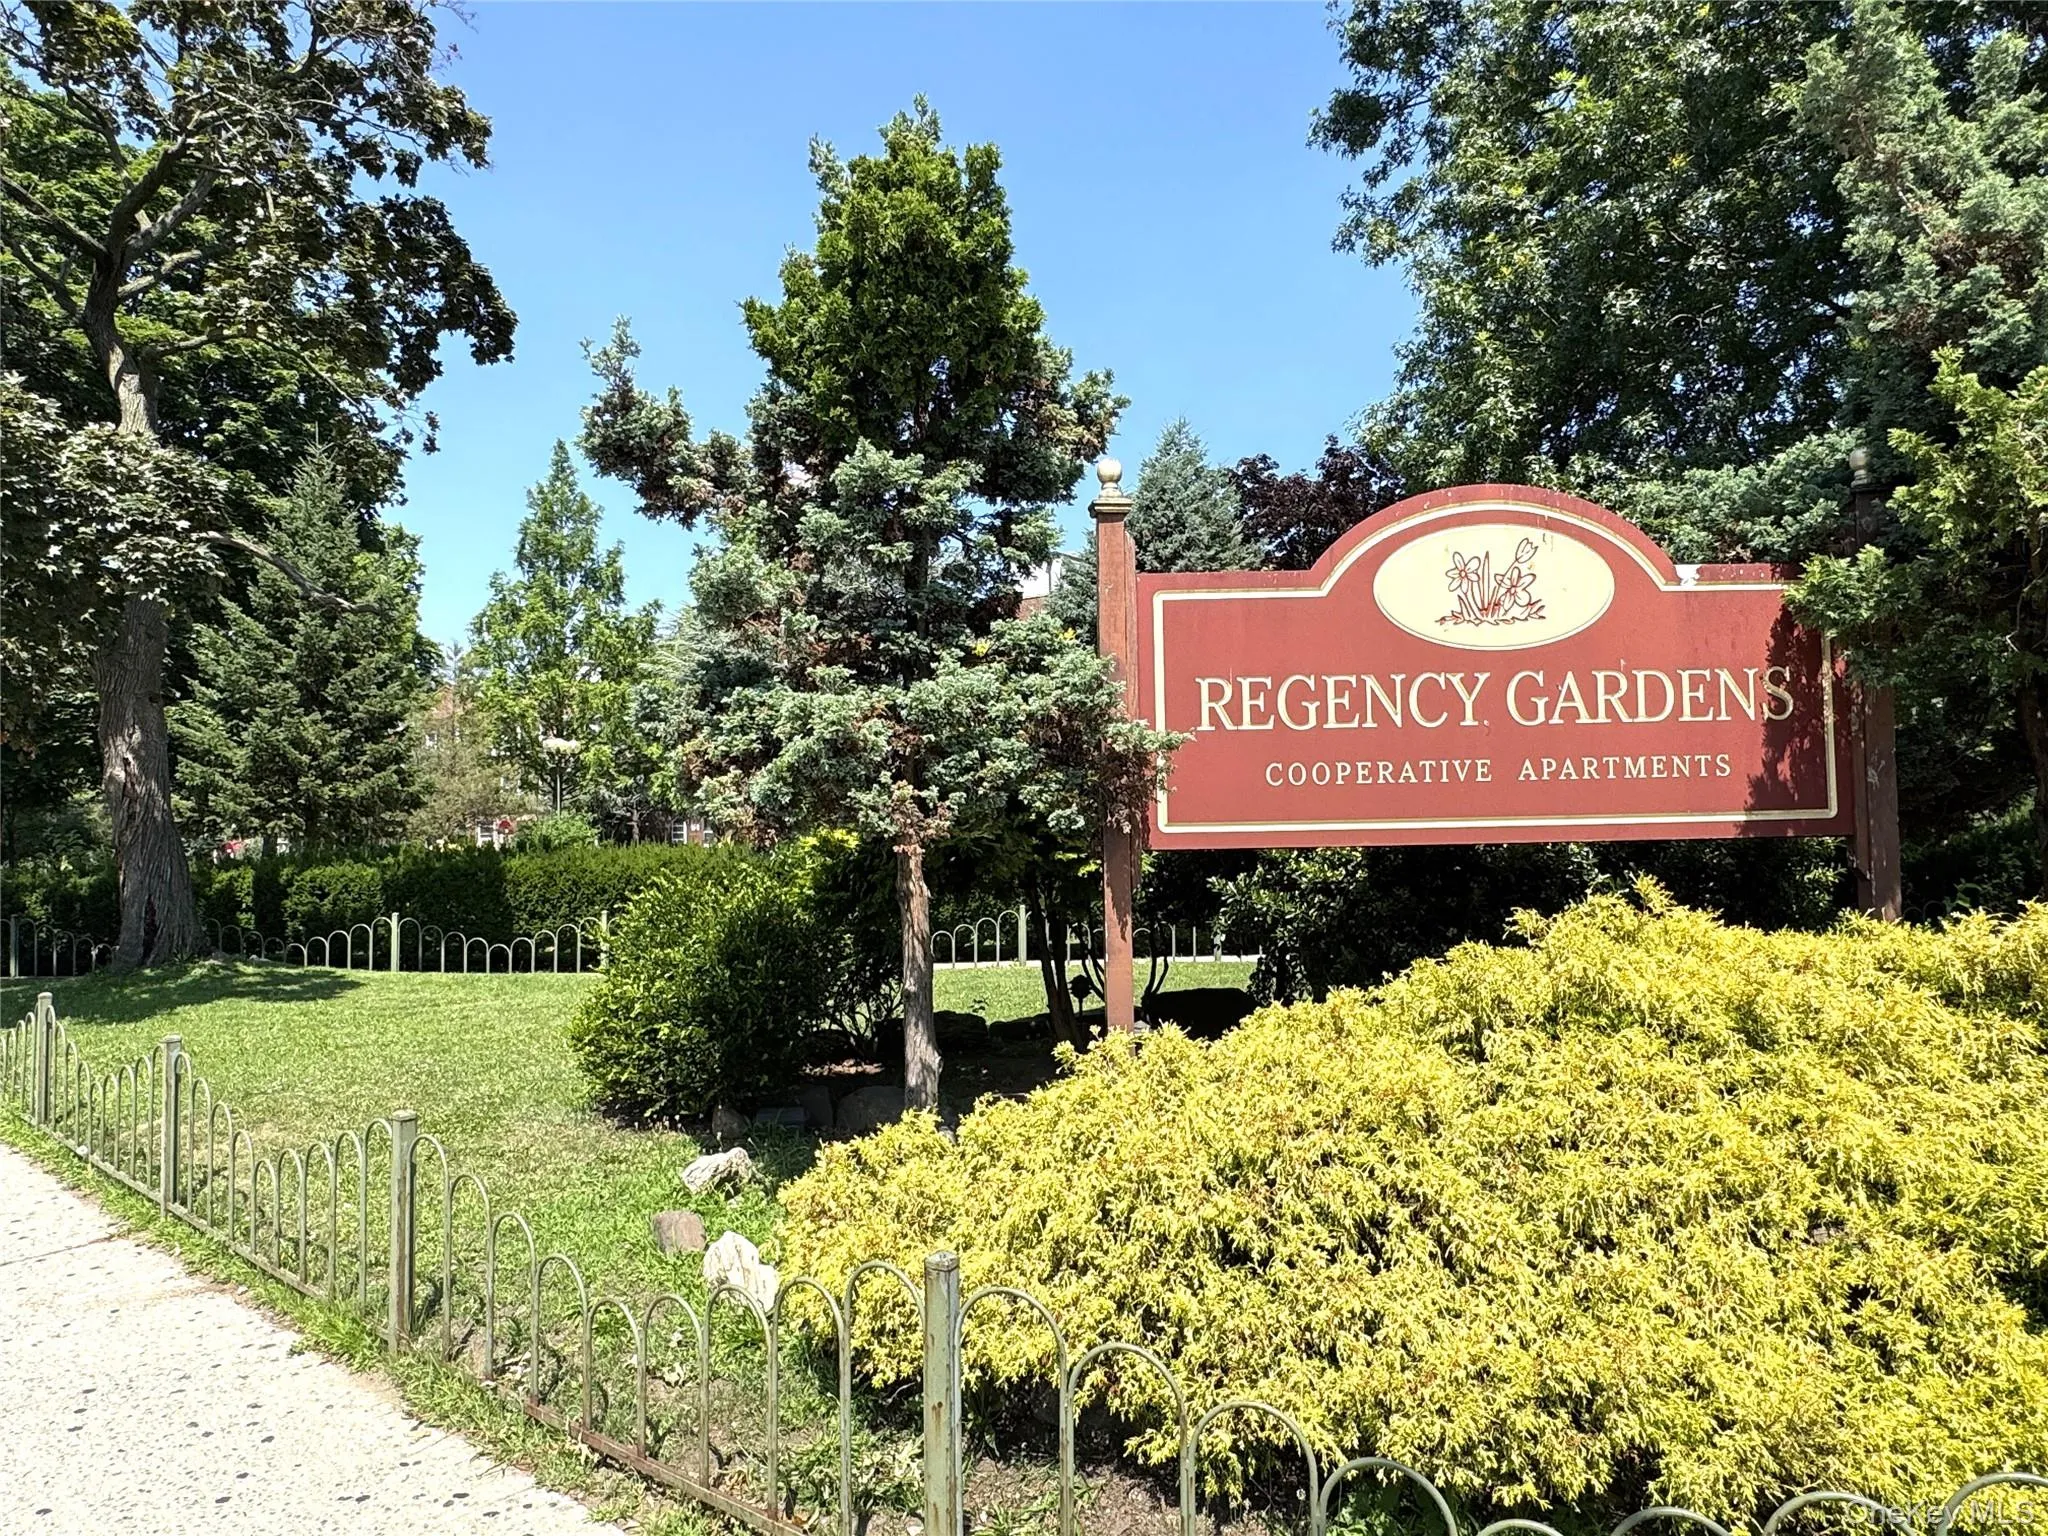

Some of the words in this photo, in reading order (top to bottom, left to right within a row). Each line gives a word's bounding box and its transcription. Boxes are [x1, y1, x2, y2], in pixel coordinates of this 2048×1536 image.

[1195, 671, 1491, 731] REGENCY
[1506, 665, 1795, 726] GARDENS
[1265, 759, 1493, 787] COOPERATIVE
[1517, 754, 1732, 782] APARTMENTS
